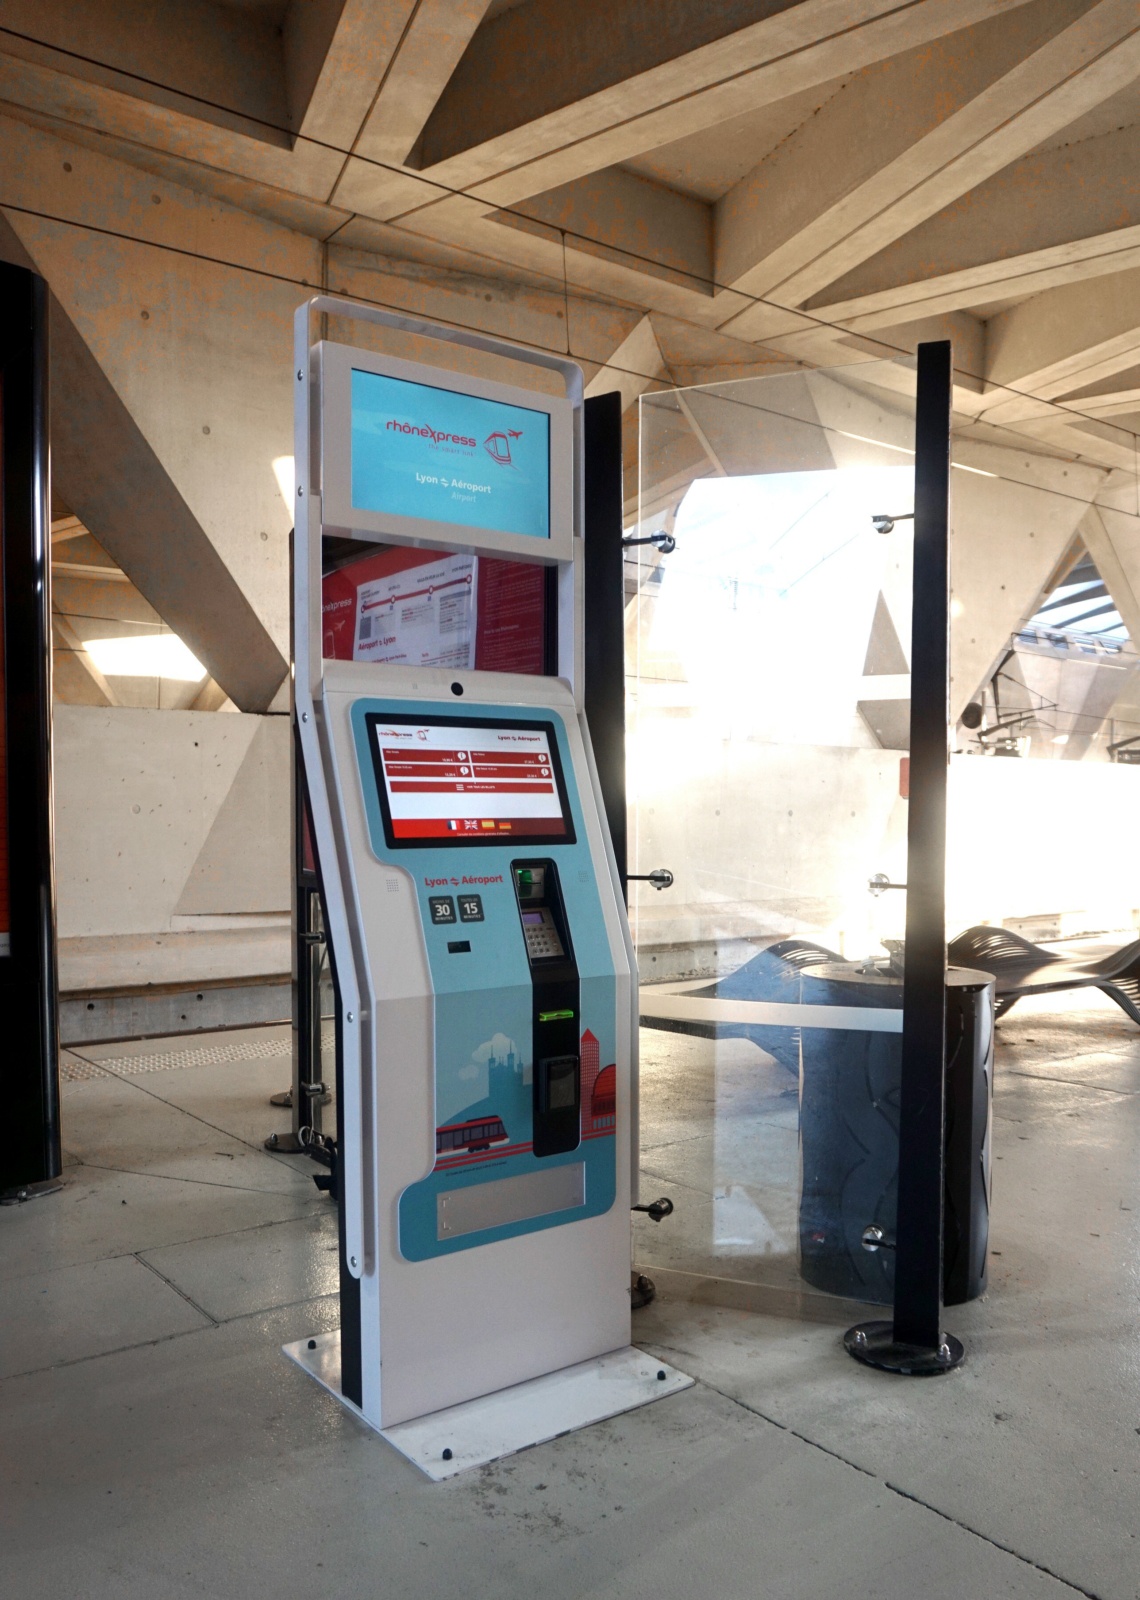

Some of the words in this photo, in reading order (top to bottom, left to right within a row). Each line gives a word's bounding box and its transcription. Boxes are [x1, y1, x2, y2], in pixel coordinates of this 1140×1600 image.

[416, 472, 438, 485] Lyon
[451, 478, 492, 494] Aéroport
[451, 491, 477, 503] Airport
[358, 638, 379, 651] Aéroport
[383, 636, 397, 646] Lyon
[425, 877, 448, 888] Lyon
[461, 875, 503, 886] Aéroport
[435, 904, 450, 916] 30
[463, 902, 478, 914] 15
